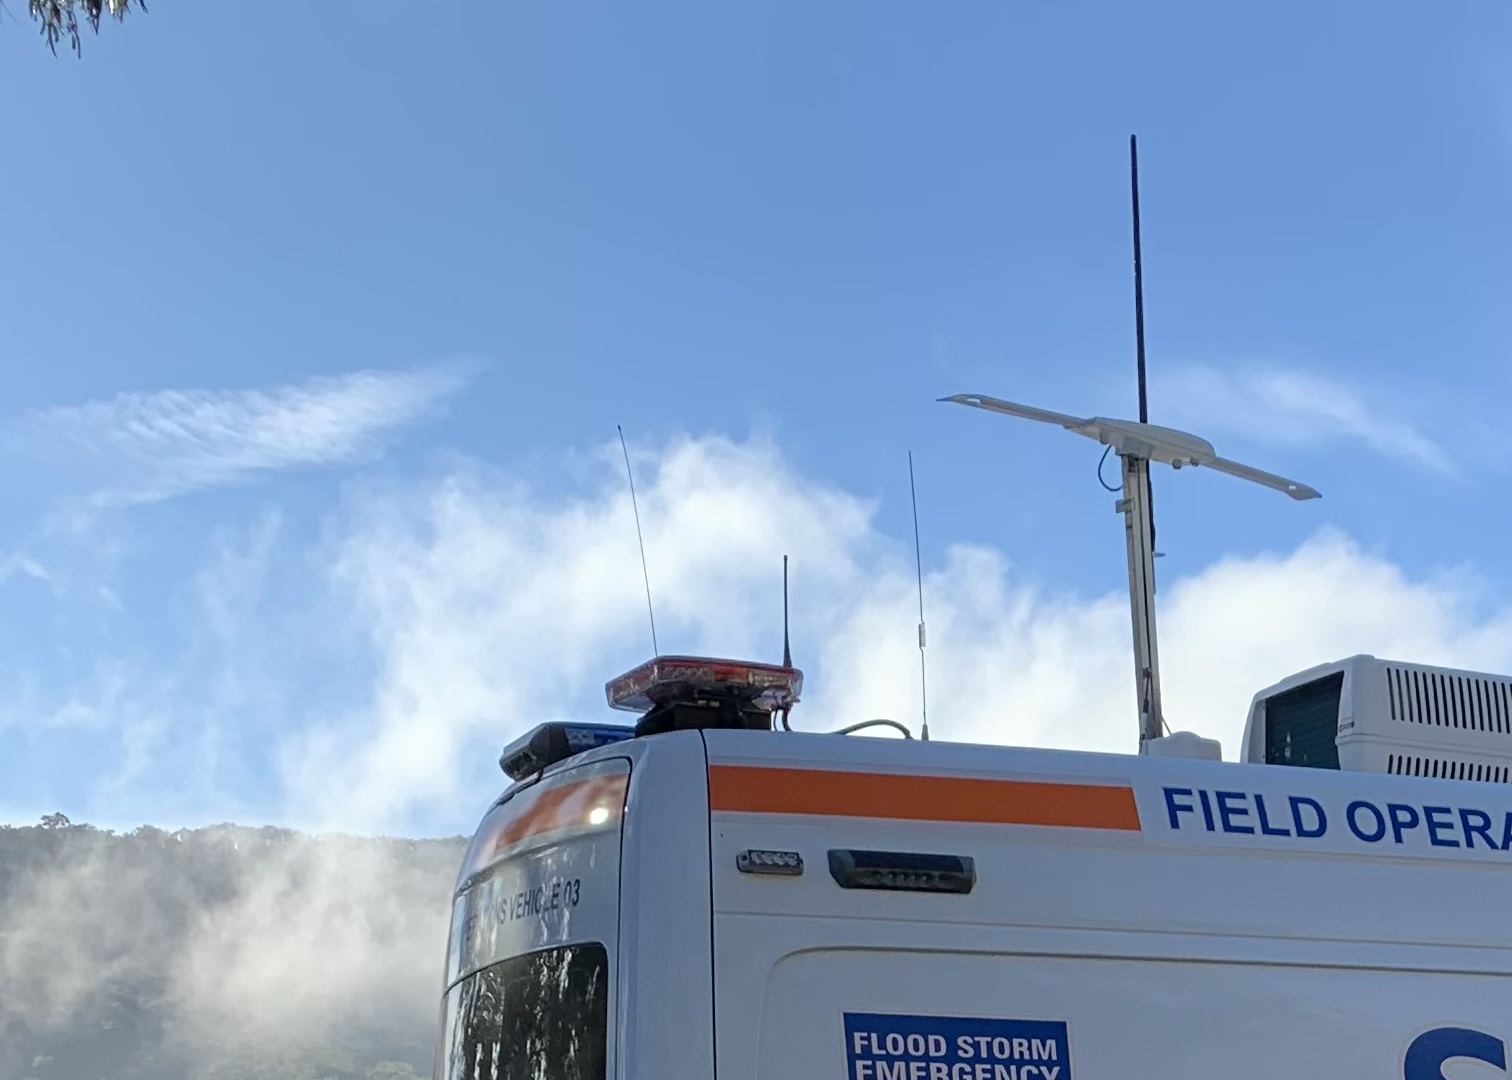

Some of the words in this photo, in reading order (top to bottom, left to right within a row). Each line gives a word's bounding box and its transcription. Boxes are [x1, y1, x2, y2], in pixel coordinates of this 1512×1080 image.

[1162, 786, 1327, 838] FIELD
[563, 878, 580, 907] 03
[853, 1032, 947, 1057] FLOOD
[957, 1036, 1058, 1060] STORM
